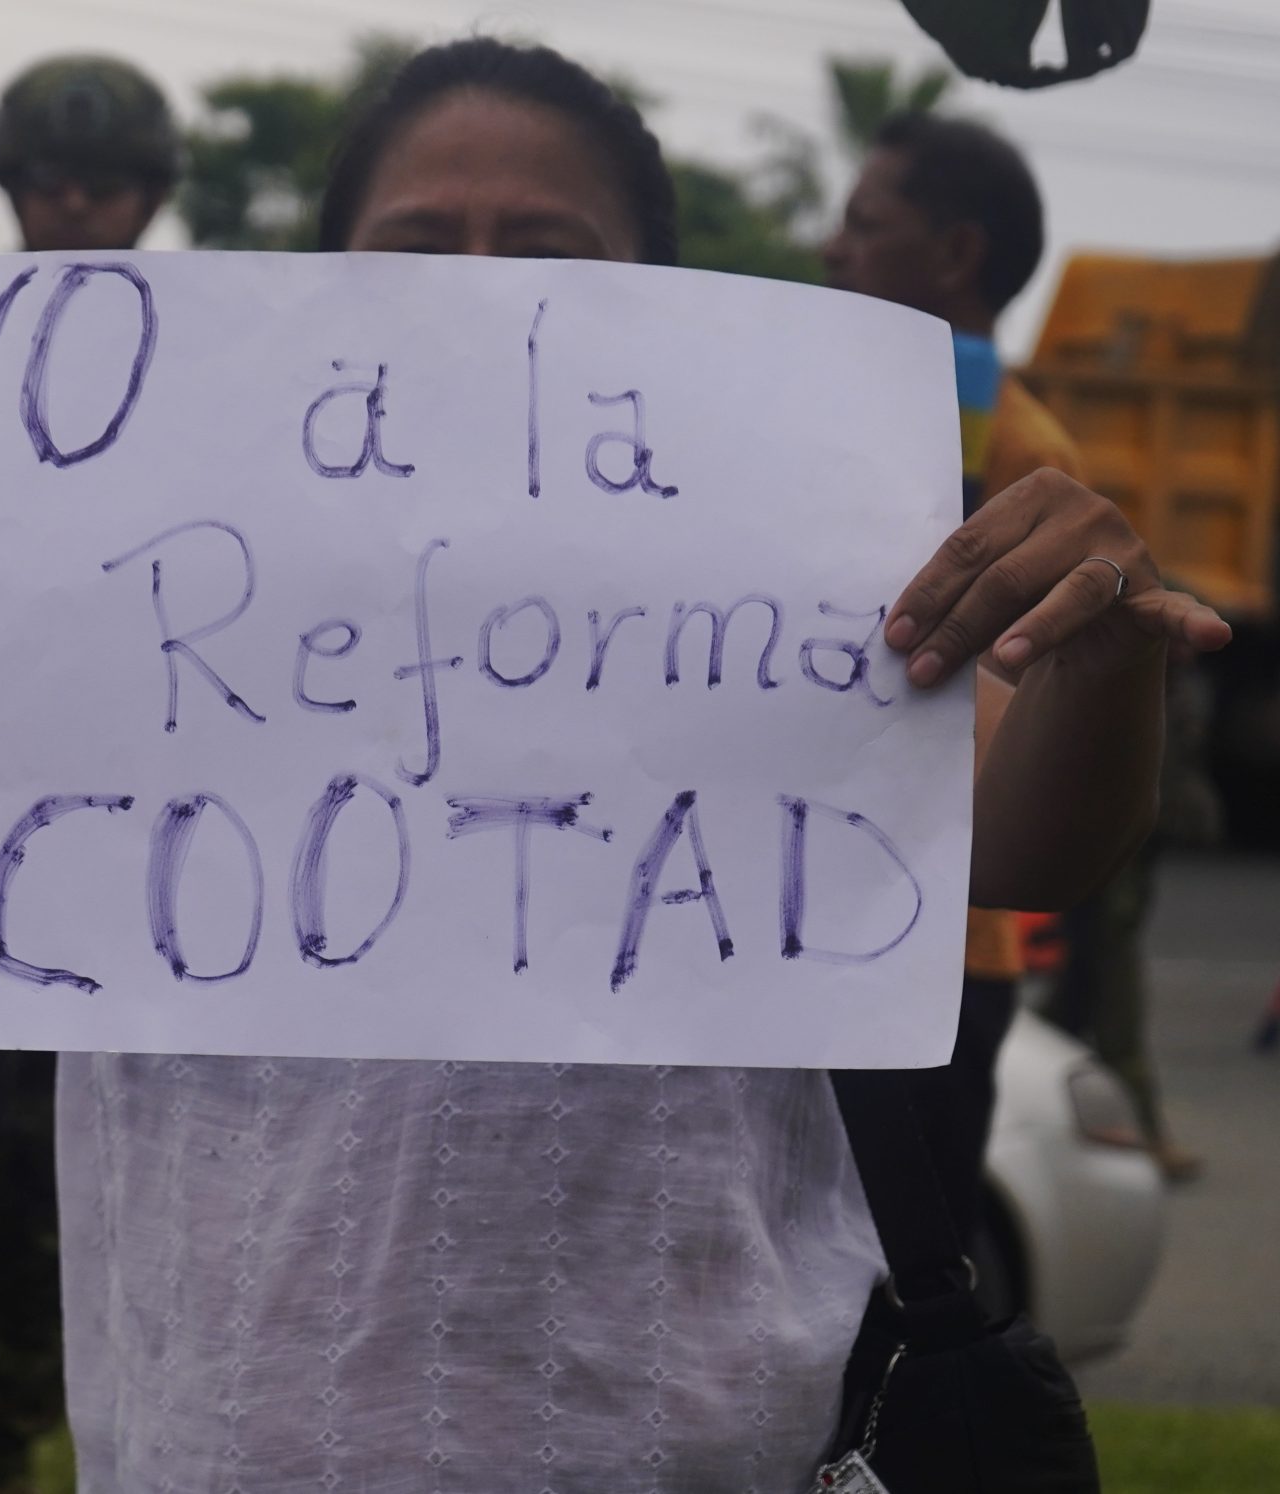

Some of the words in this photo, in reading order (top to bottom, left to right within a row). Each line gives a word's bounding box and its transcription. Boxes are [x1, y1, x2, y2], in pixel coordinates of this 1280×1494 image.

[301, 361, 417, 480] a
[525, 298, 680, 500] la
[101, 520, 896, 789] Reforma
